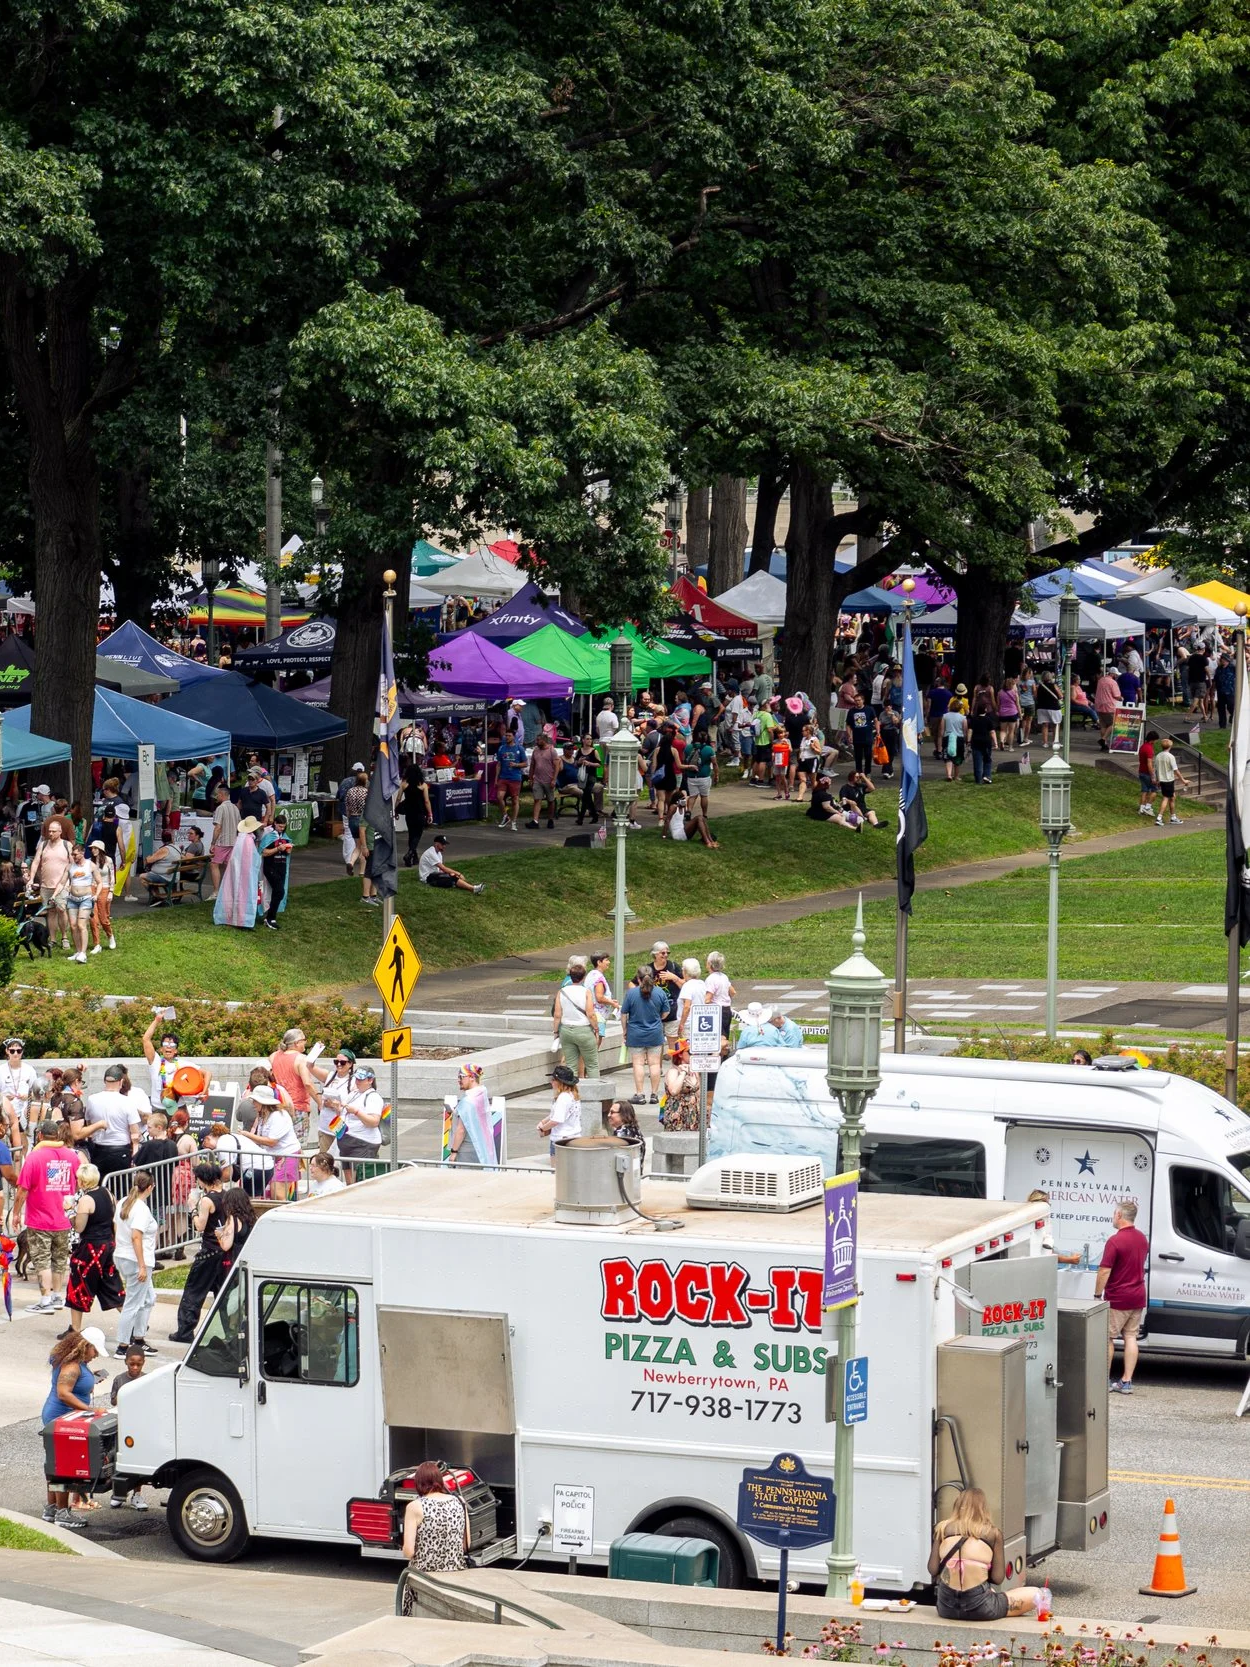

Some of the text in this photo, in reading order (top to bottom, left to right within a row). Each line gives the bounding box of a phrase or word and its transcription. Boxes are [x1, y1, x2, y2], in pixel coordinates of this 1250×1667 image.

[488, 613, 542, 626] xfinity
[728, 628, 755, 636] FIRST.
[928, 627, 953, 635] SOCIETY
[283, 656, 308, 664] PROTECT,
[290, 808, 308, 820] SIERRA
[290, 820, 302, 831] CLUB
[800, 1026, 830, 1035] APITOL
[1041, 1179, 1132, 1193] PENNSYLVANIA
[1047, 1190, 1140, 1207] ERICAN WATER
[1091, 1215, 1113, 1224] FLOWI
[1182, 1282, 1241, 1293] PENNSYLVANIA
[600, 1256, 824, 1335] ROCK-IT
[1176, 1287, 1246, 1302] AMERICAN WATER
[981, 1297, 1047, 1327] ROCK-IT
[981, 1321, 1045, 1337] PIZZA & SUBS
[604, 1332, 829, 1376] PIZZA & SUBS
[643, 1368, 790, 1393] Newberrytown, PA
[630, 1390, 803, 1425] 717-938-1773
[555, 1489, 592, 1499] PA CAPITOL
[746, 1482, 829, 1501] THE PENNSYLVANIA
[561, 1501, 587, 1510] POLICE
[754, 1492, 819, 1508] STATE CAPITOL
[759, 1502, 796, 1513] Commonwealth
[796, 1506, 820, 1516] Treasure
[554, 1533, 577, 1541] HOLDING
[560, 1527, 585, 1535] FIREARMS
